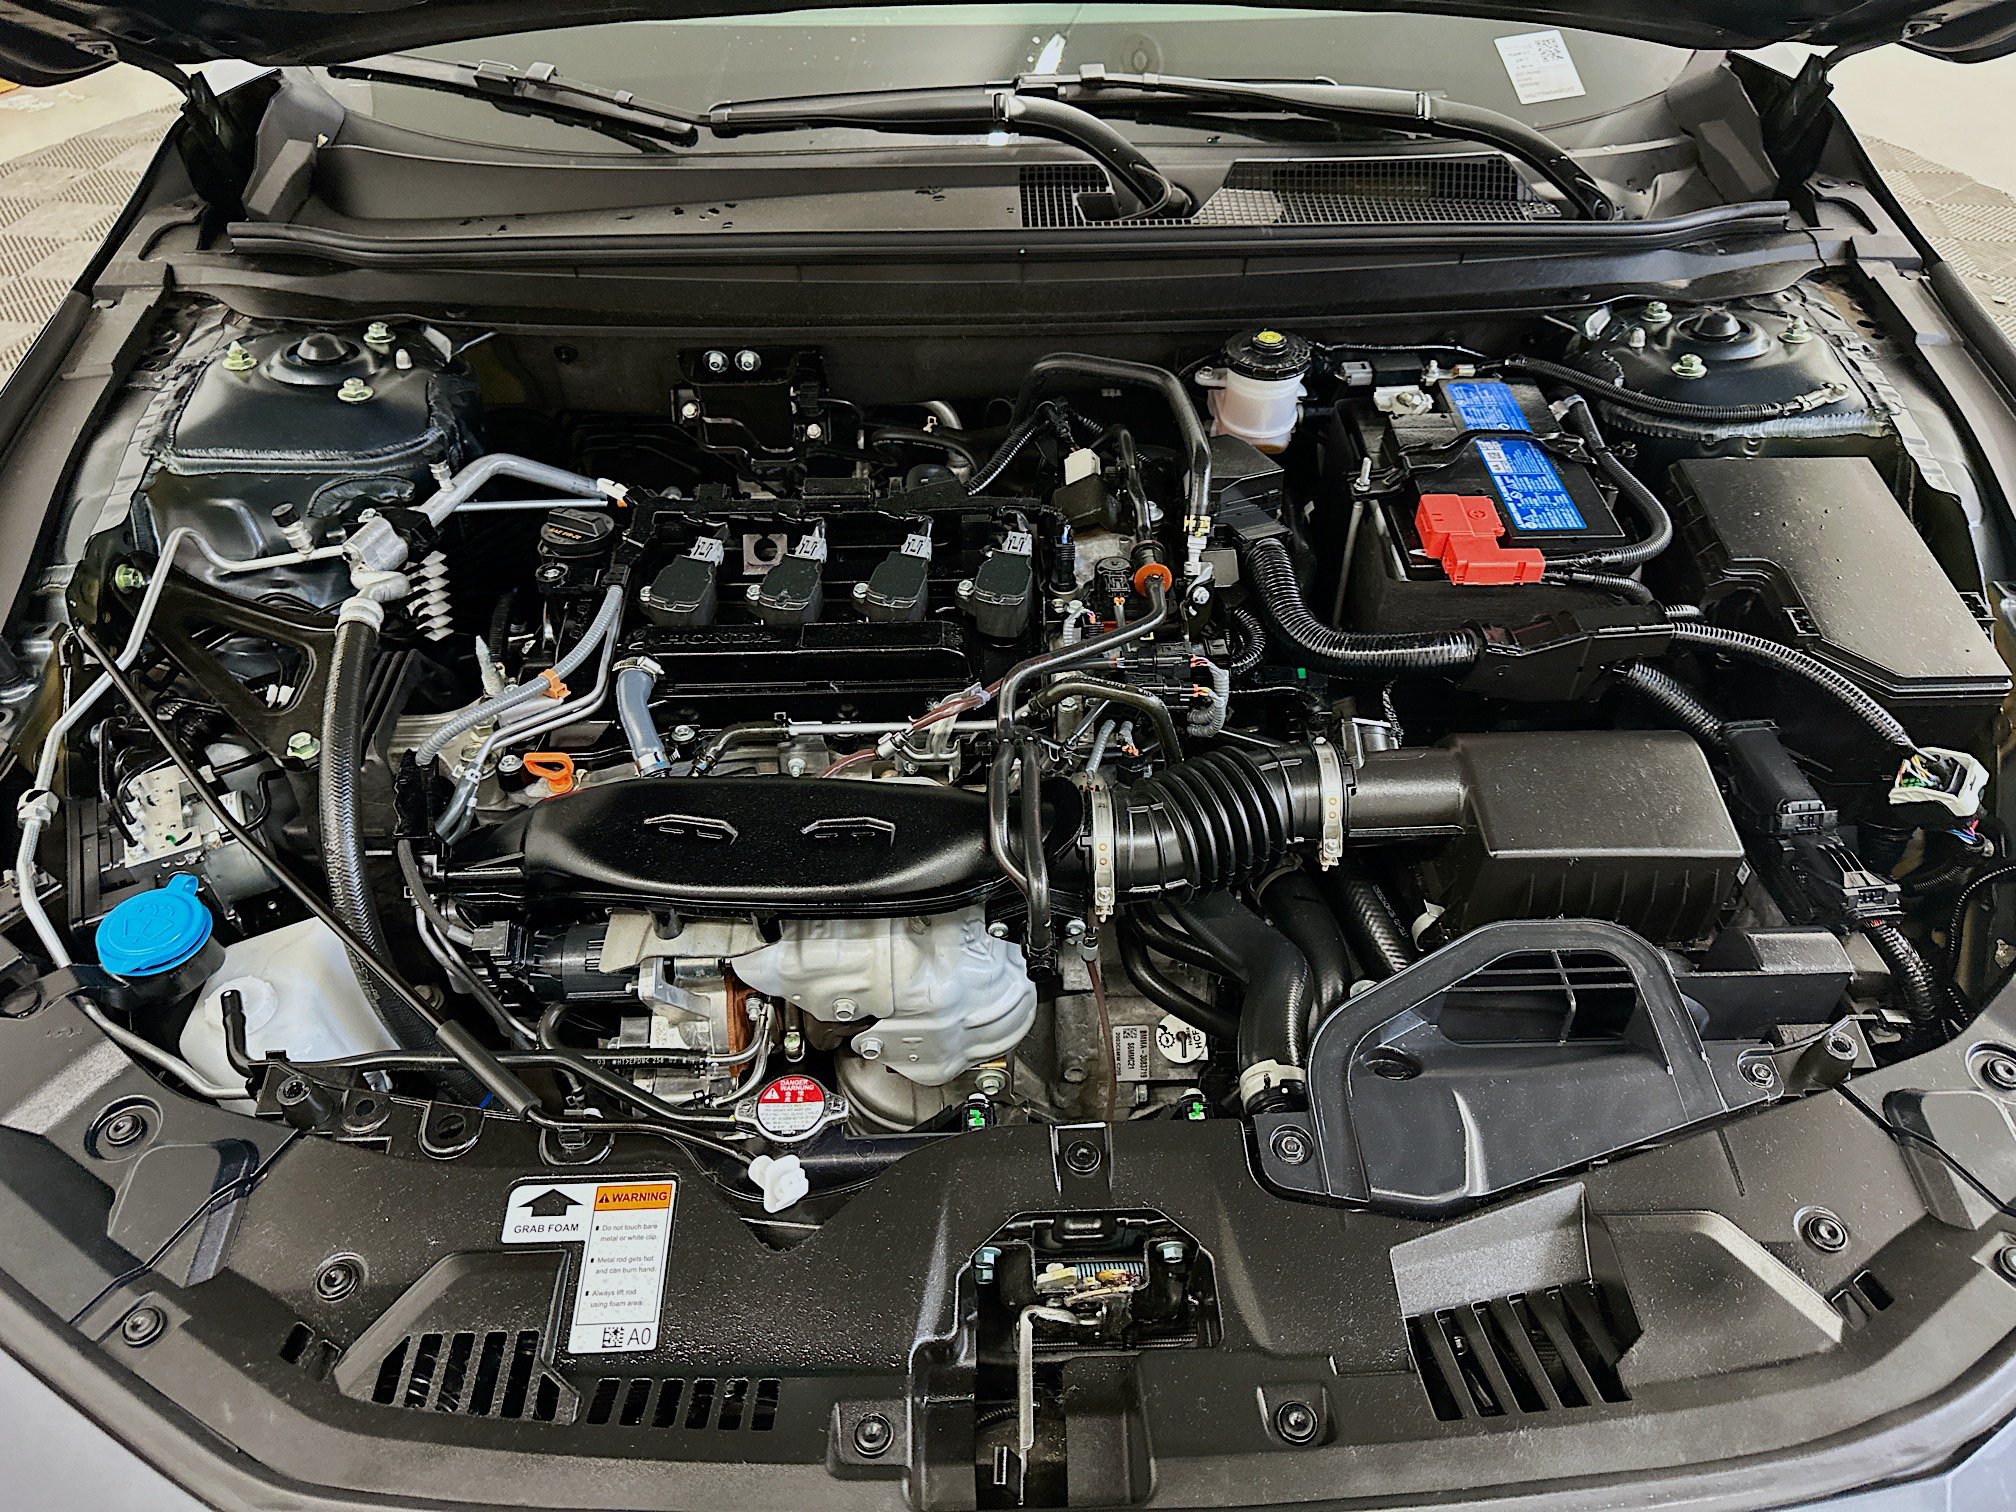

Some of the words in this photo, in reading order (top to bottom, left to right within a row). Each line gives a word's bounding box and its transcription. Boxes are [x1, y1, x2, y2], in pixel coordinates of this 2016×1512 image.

[1191, 1030, 1202, 1048] HCF
[612, 1191, 668, 1202] WARNING
[513, 1224, 545, 1234] GRAB
[547, 1223, 579, 1232] FOAM
[624, 1223, 642, 1231] touch
[600, 1234, 619, 1242] metal
[592, 1289, 615, 1297] Always
[627, 1327, 651, 1345] A0
